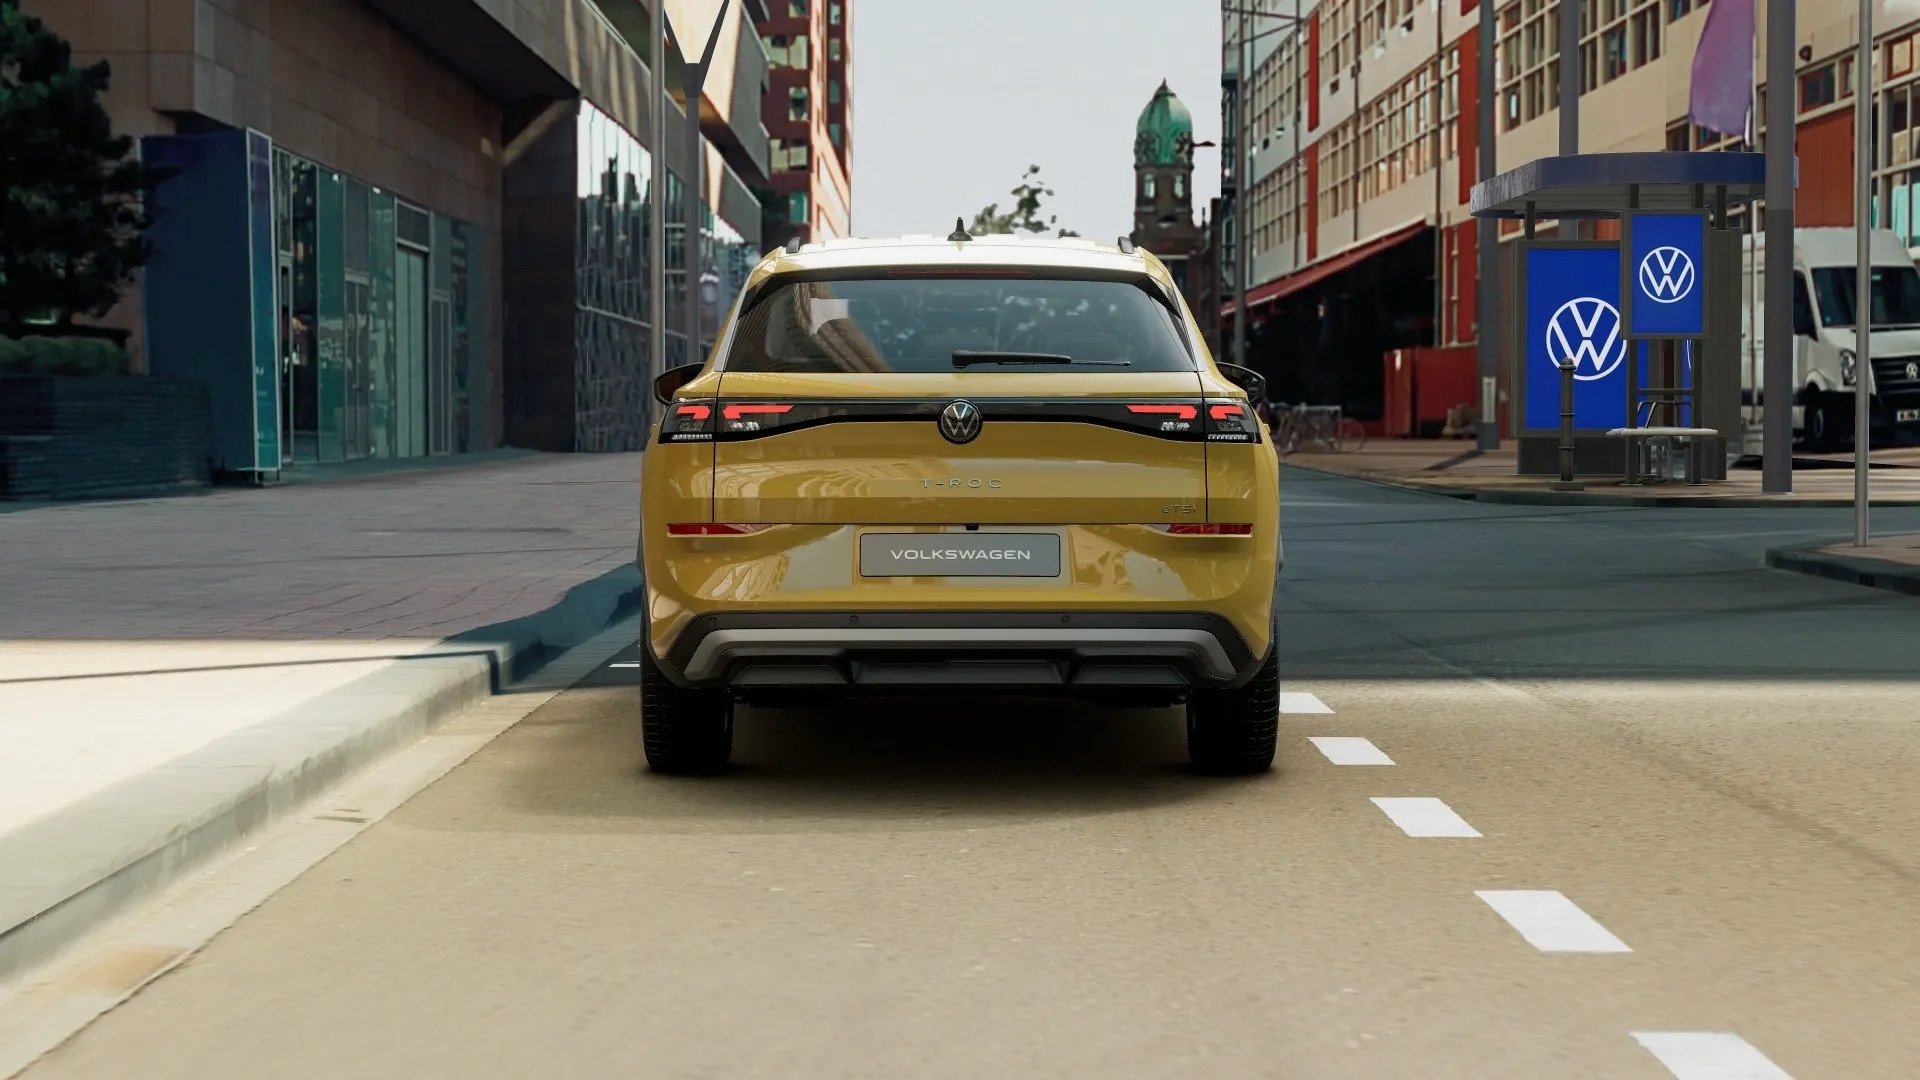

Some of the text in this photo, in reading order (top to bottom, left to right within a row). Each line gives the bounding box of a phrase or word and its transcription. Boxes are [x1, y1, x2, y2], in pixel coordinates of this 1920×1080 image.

[1640, 247, 1694, 301] VW
[1547, 297, 1622, 374] VW
[941, 402, 979, 440] VW
[919, 478, 1004, 489] T-ROC
[890, 549, 1031, 561] VOLKSWAGEN
